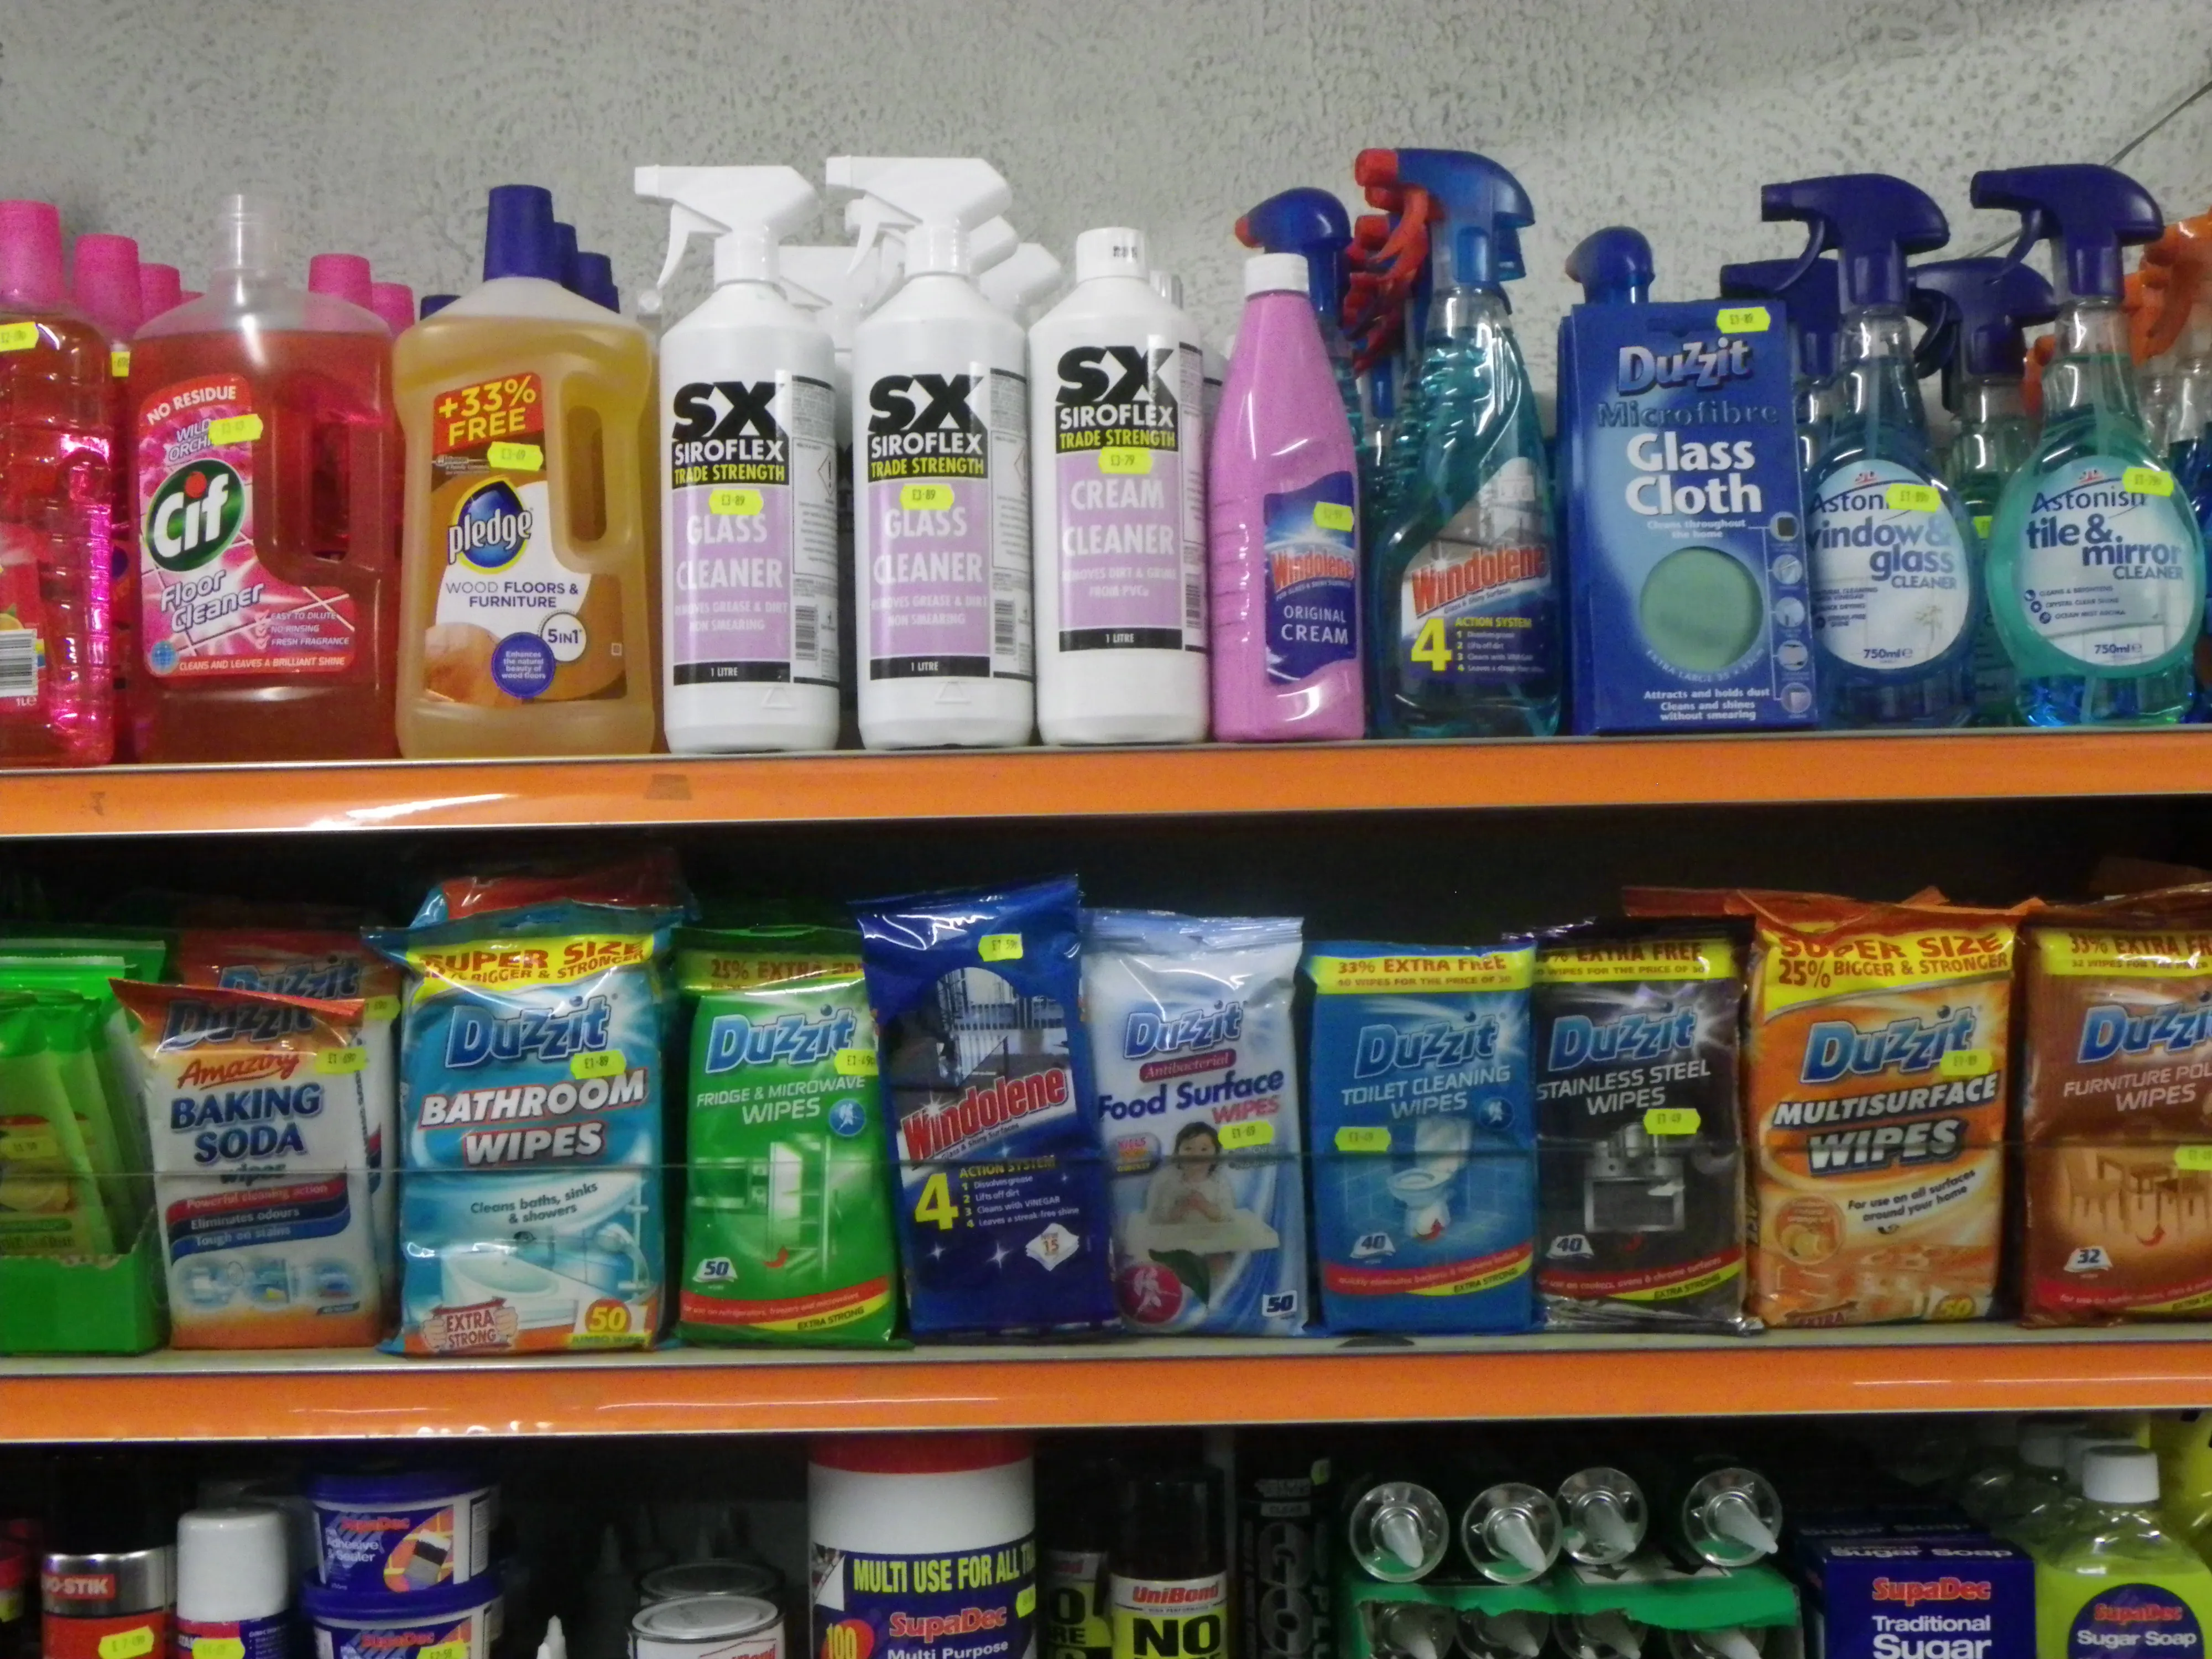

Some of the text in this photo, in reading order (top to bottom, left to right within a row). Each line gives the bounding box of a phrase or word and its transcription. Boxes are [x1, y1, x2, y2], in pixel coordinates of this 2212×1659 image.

[147, 386, 236, 425] NO RESIDUE
[1060, 404, 1174, 430] SIROFLEX
[448, 406, 526, 447] FREE
[1060, 429, 1175, 449] TRADE STRENGTH
[675, 439, 784, 466] SIROFLEX
[871, 432, 983, 458] SIROFLEX
[1626, 431, 1755, 472] Glass
[675, 464, 785, 484] TRADE STRENGTH
[871, 457, 984, 478] TRADE STRENGTH
[1071, 478, 1165, 510] CREAM
[1625, 473, 1762, 515] Cloth
[153, 471, 230, 559] Cif
[448, 508, 533, 565] pledge
[1062, 524, 1175, 557] CLEANER
[2026, 513, 2112, 549] tile &
[1869, 543, 1954, 582] glass
[2082, 535, 2182, 566] mirror
[676, 557, 783, 591] CLEANER
[1891, 575, 1957, 589] CLEANER
[2113, 566, 2183, 580] CLEANER
[161, 569, 227, 613] Floor
[446, 582, 578, 594] WOOD FLOORS &
[171, 583, 264, 633] Cleaner
[469, 596, 557, 608] FURNITURE
[1284, 605, 1347, 623] ORIGINAL
[1281, 624, 1348, 645] CREAM
[1455, 618, 1532, 628] ACTION SYSTEM
[1113, 634, 1134, 643] LITRE
[1411, 618, 1453, 672] 4
[179, 662, 209, 671] CLEANS
[211, 661, 229, 670] AND
[231, 659, 262, 669] LEAVES
[273, 657, 317, 667] BRILLIANT
[319, 657, 345, 665] SHINE
[717, 667, 738, 677] LITRE
[917, 662, 938, 671] LITRE
[1644, 687, 1770, 699] Attracts and holds dust
[1660, 700, 1756, 711] Cleans and shines
[1660, 710, 1756, 722] without smearing
[1338, 955, 1506, 974] 33% EXTRA FREE
[1778, 951, 2008, 988] 25% BIGGER & STRONGER
[445, 995, 612, 1068] Duzzit
[1354, 1011, 1499, 1079] Duzzit
[1548, 1002, 1698, 1072] Duzzit
[697, 1076, 865, 1107] FRIDGE & MICROWAVE
[1342, 1066, 1510, 1105] TOILET CLEANING
[1536, 1060, 1711, 1100] STAINLESS STEEL
[171, 1082, 321, 1129] BAKING
[420, 1068, 646, 1126] BATHROOM
[1099, 1070, 1284, 1121] Food Surface
[1391, 1092, 1467, 1119] WIPES
[1587, 1087, 1666, 1115] WIPES
[1774, 1072, 1998, 1126] MULTISURFACE
[2116, 1083, 2196, 1112] WIPES
[742, 1097, 820, 1125] WIPES
[901, 1067, 1068, 1170] Windolene
[194, 1123, 305, 1162] SODA
[466, 1122, 603, 1165] WIPES
[1809, 1118, 1961, 1170] WIPES
[186, 1193, 239, 1209] Powerful
[293, 1185, 328, 1195] action
[471, 1182, 598, 1214] Cleans baths, sinks
[915, 1173, 959, 1230] 4
[1848, 1170, 1976, 1210] For use on all surfaces
[1863, 1185, 1968, 1222] around your home
[191, 1208, 300, 1229] Eliminates odours
[508, 1203, 577, 1224] & showers
[966, 1196, 1060, 1216] 3 Cleans with VINEGAR
[196, 1233, 232, 1246] Tough
[255, 1227, 291, 1238] stains
[1361, 1235, 1385, 1249] 40
[1557, 1238, 1583, 1252] 40
[704, 1260, 729, 1276] 50
[2078, 1249, 2100, 1263] 32
[1454, 1268, 1518, 1292] EXTRA STRONG
[1654, 1273, 1720, 1299] EXTRA STRONG
[589, 1307, 627, 1328] 50
[797, 1306, 864, 1329] EXTRA STRONG
[1266, 1295, 1293, 1313] 50
[446, 1311, 494, 1332] EXTRA
[448, 1328, 497, 1349] STRONG
[1831, 1546, 2013, 1558] Sugar Soap
[853, 1558, 907, 1593] MULTI
[913, 1559, 952, 1593] USE
[958, 1554, 992, 1590] FOR
[995, 1547, 1020, 1584] ALL
[1872, 1577, 1991, 1607] SupaDec
[889, 1606, 1007, 1644] SupaDec
[1133, 1614, 1220, 1657] NO
[1872, 1614, 1991, 1632] Traditional
[887, 1641, 1009, 1659] Multi Purpose
[2077, 1629, 2197, 1649] Sugar Soap
